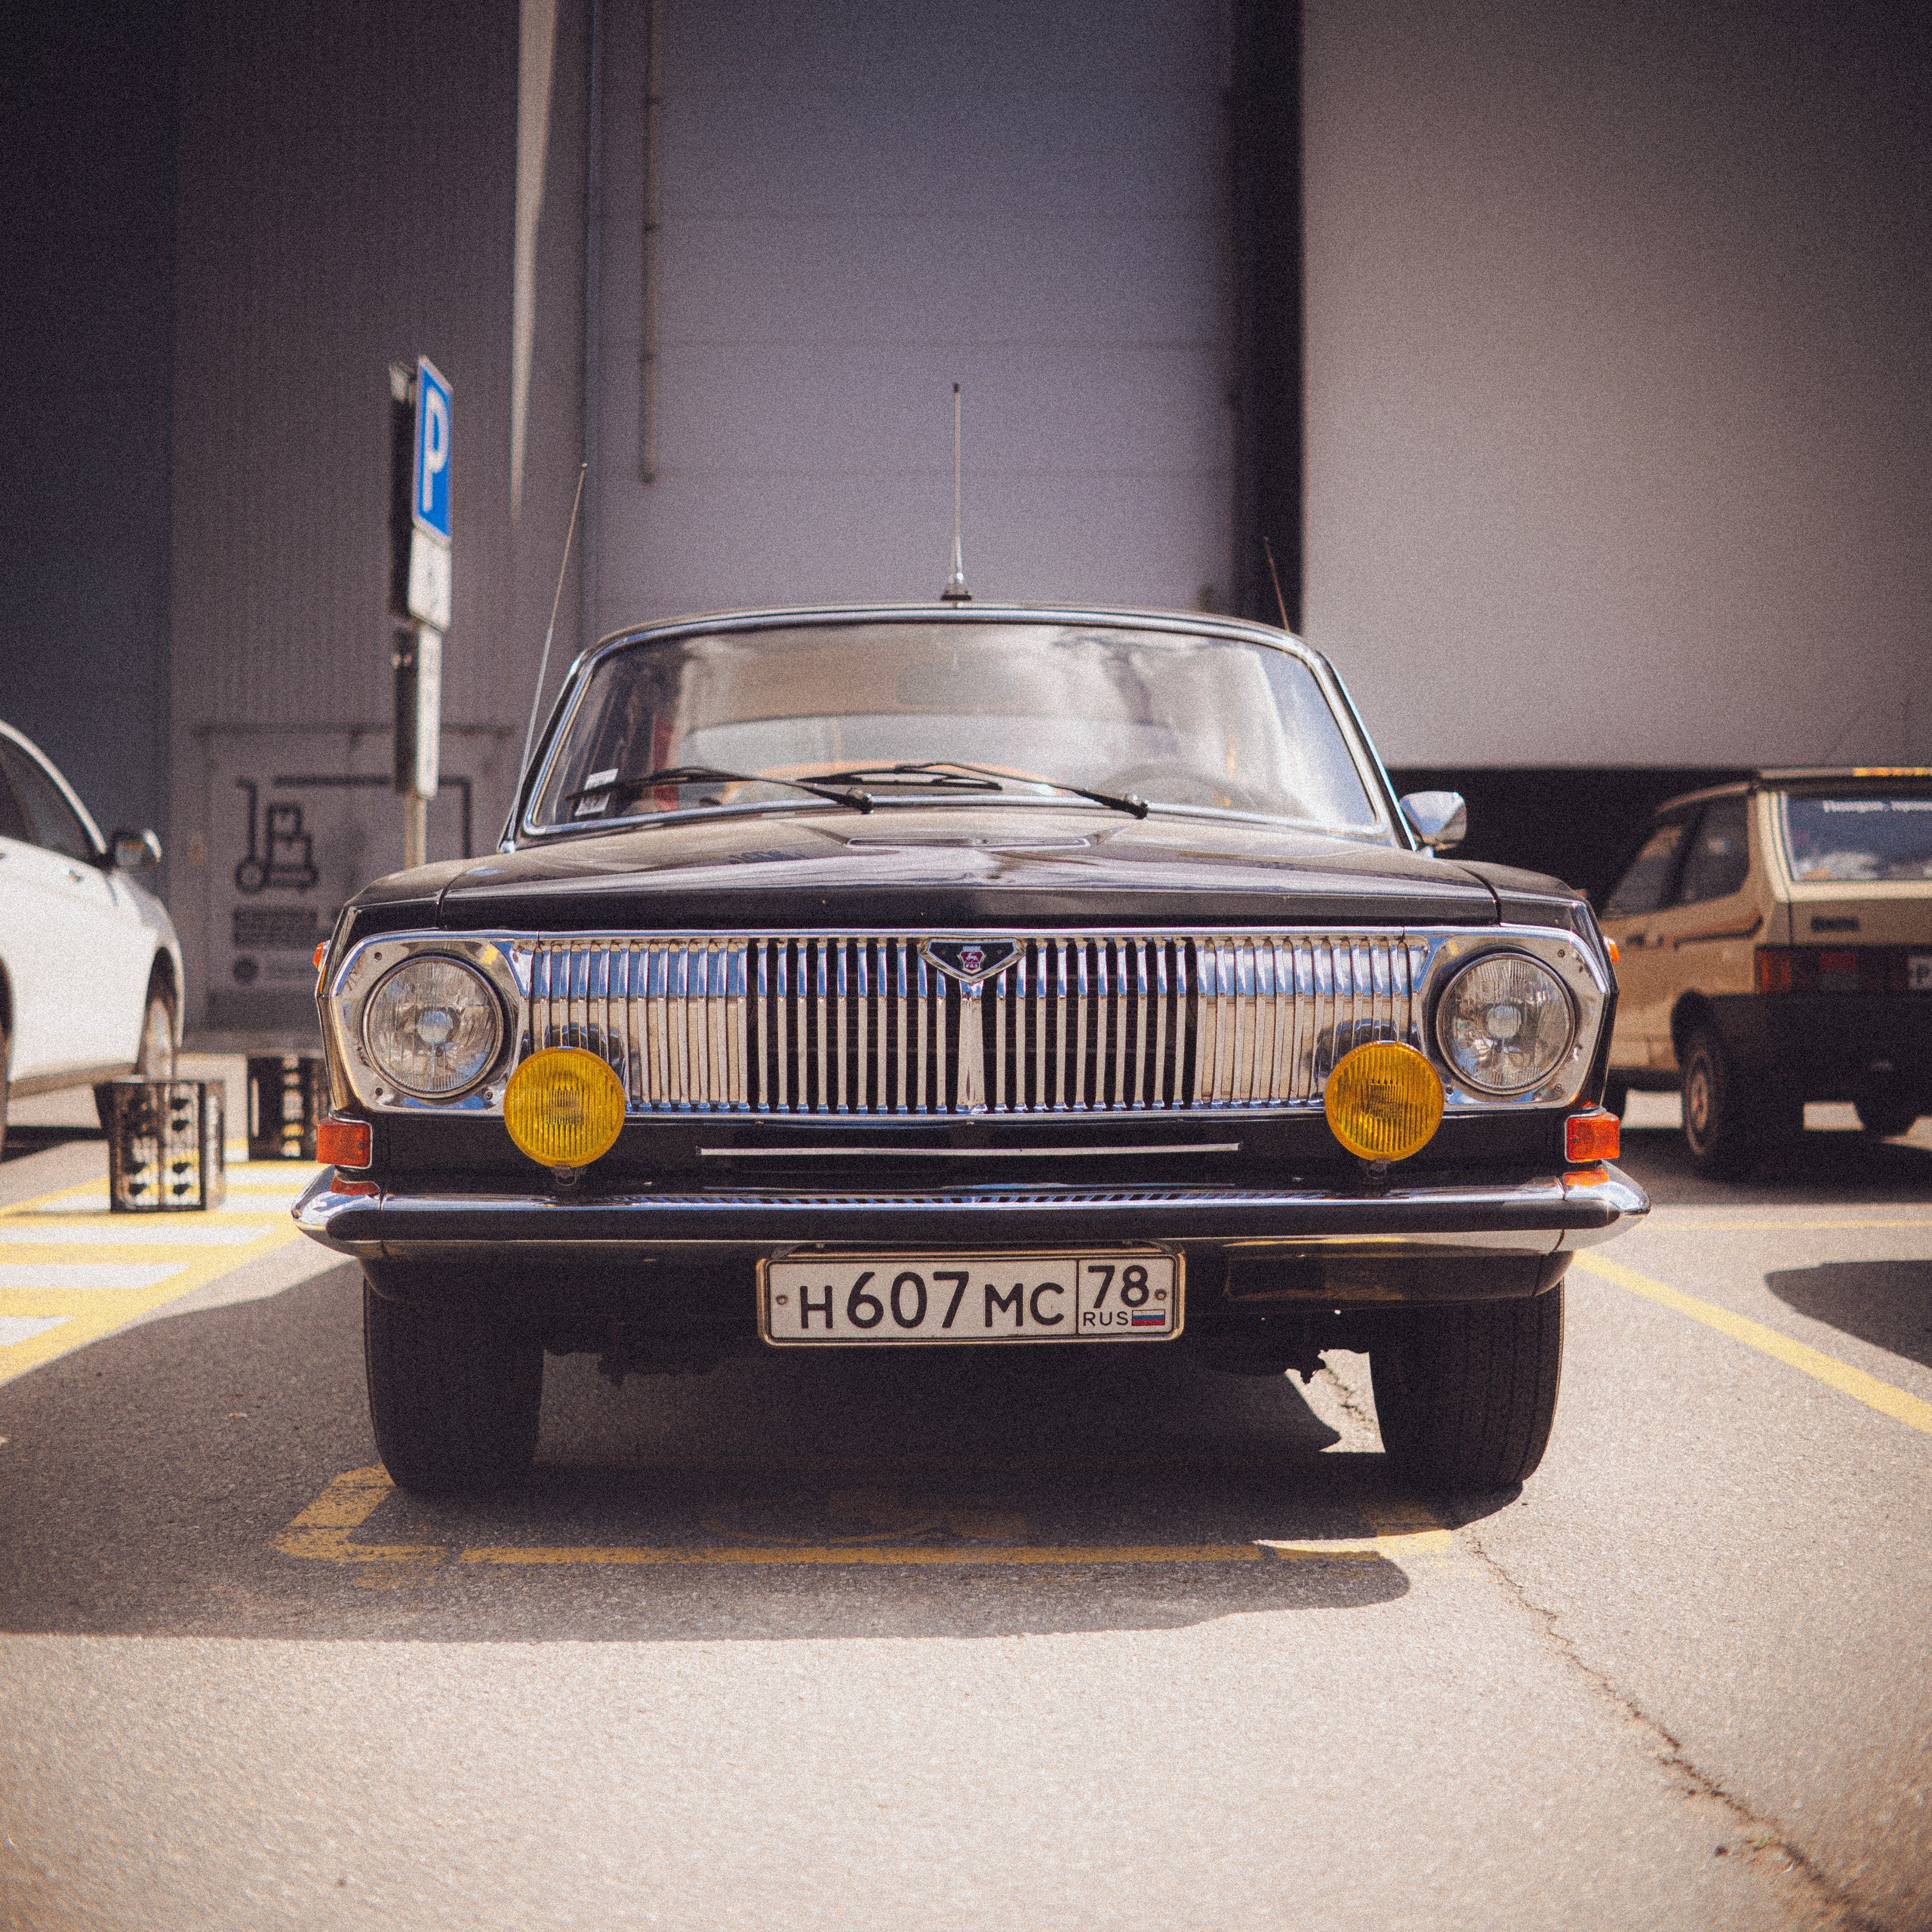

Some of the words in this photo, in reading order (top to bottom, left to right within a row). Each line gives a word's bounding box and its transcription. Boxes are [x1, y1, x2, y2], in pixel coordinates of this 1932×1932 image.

[423, 388, 448, 512] P
[1088, 1264, 1150, 1309] 78
[1083, 1311, 1129, 1327] RUS
